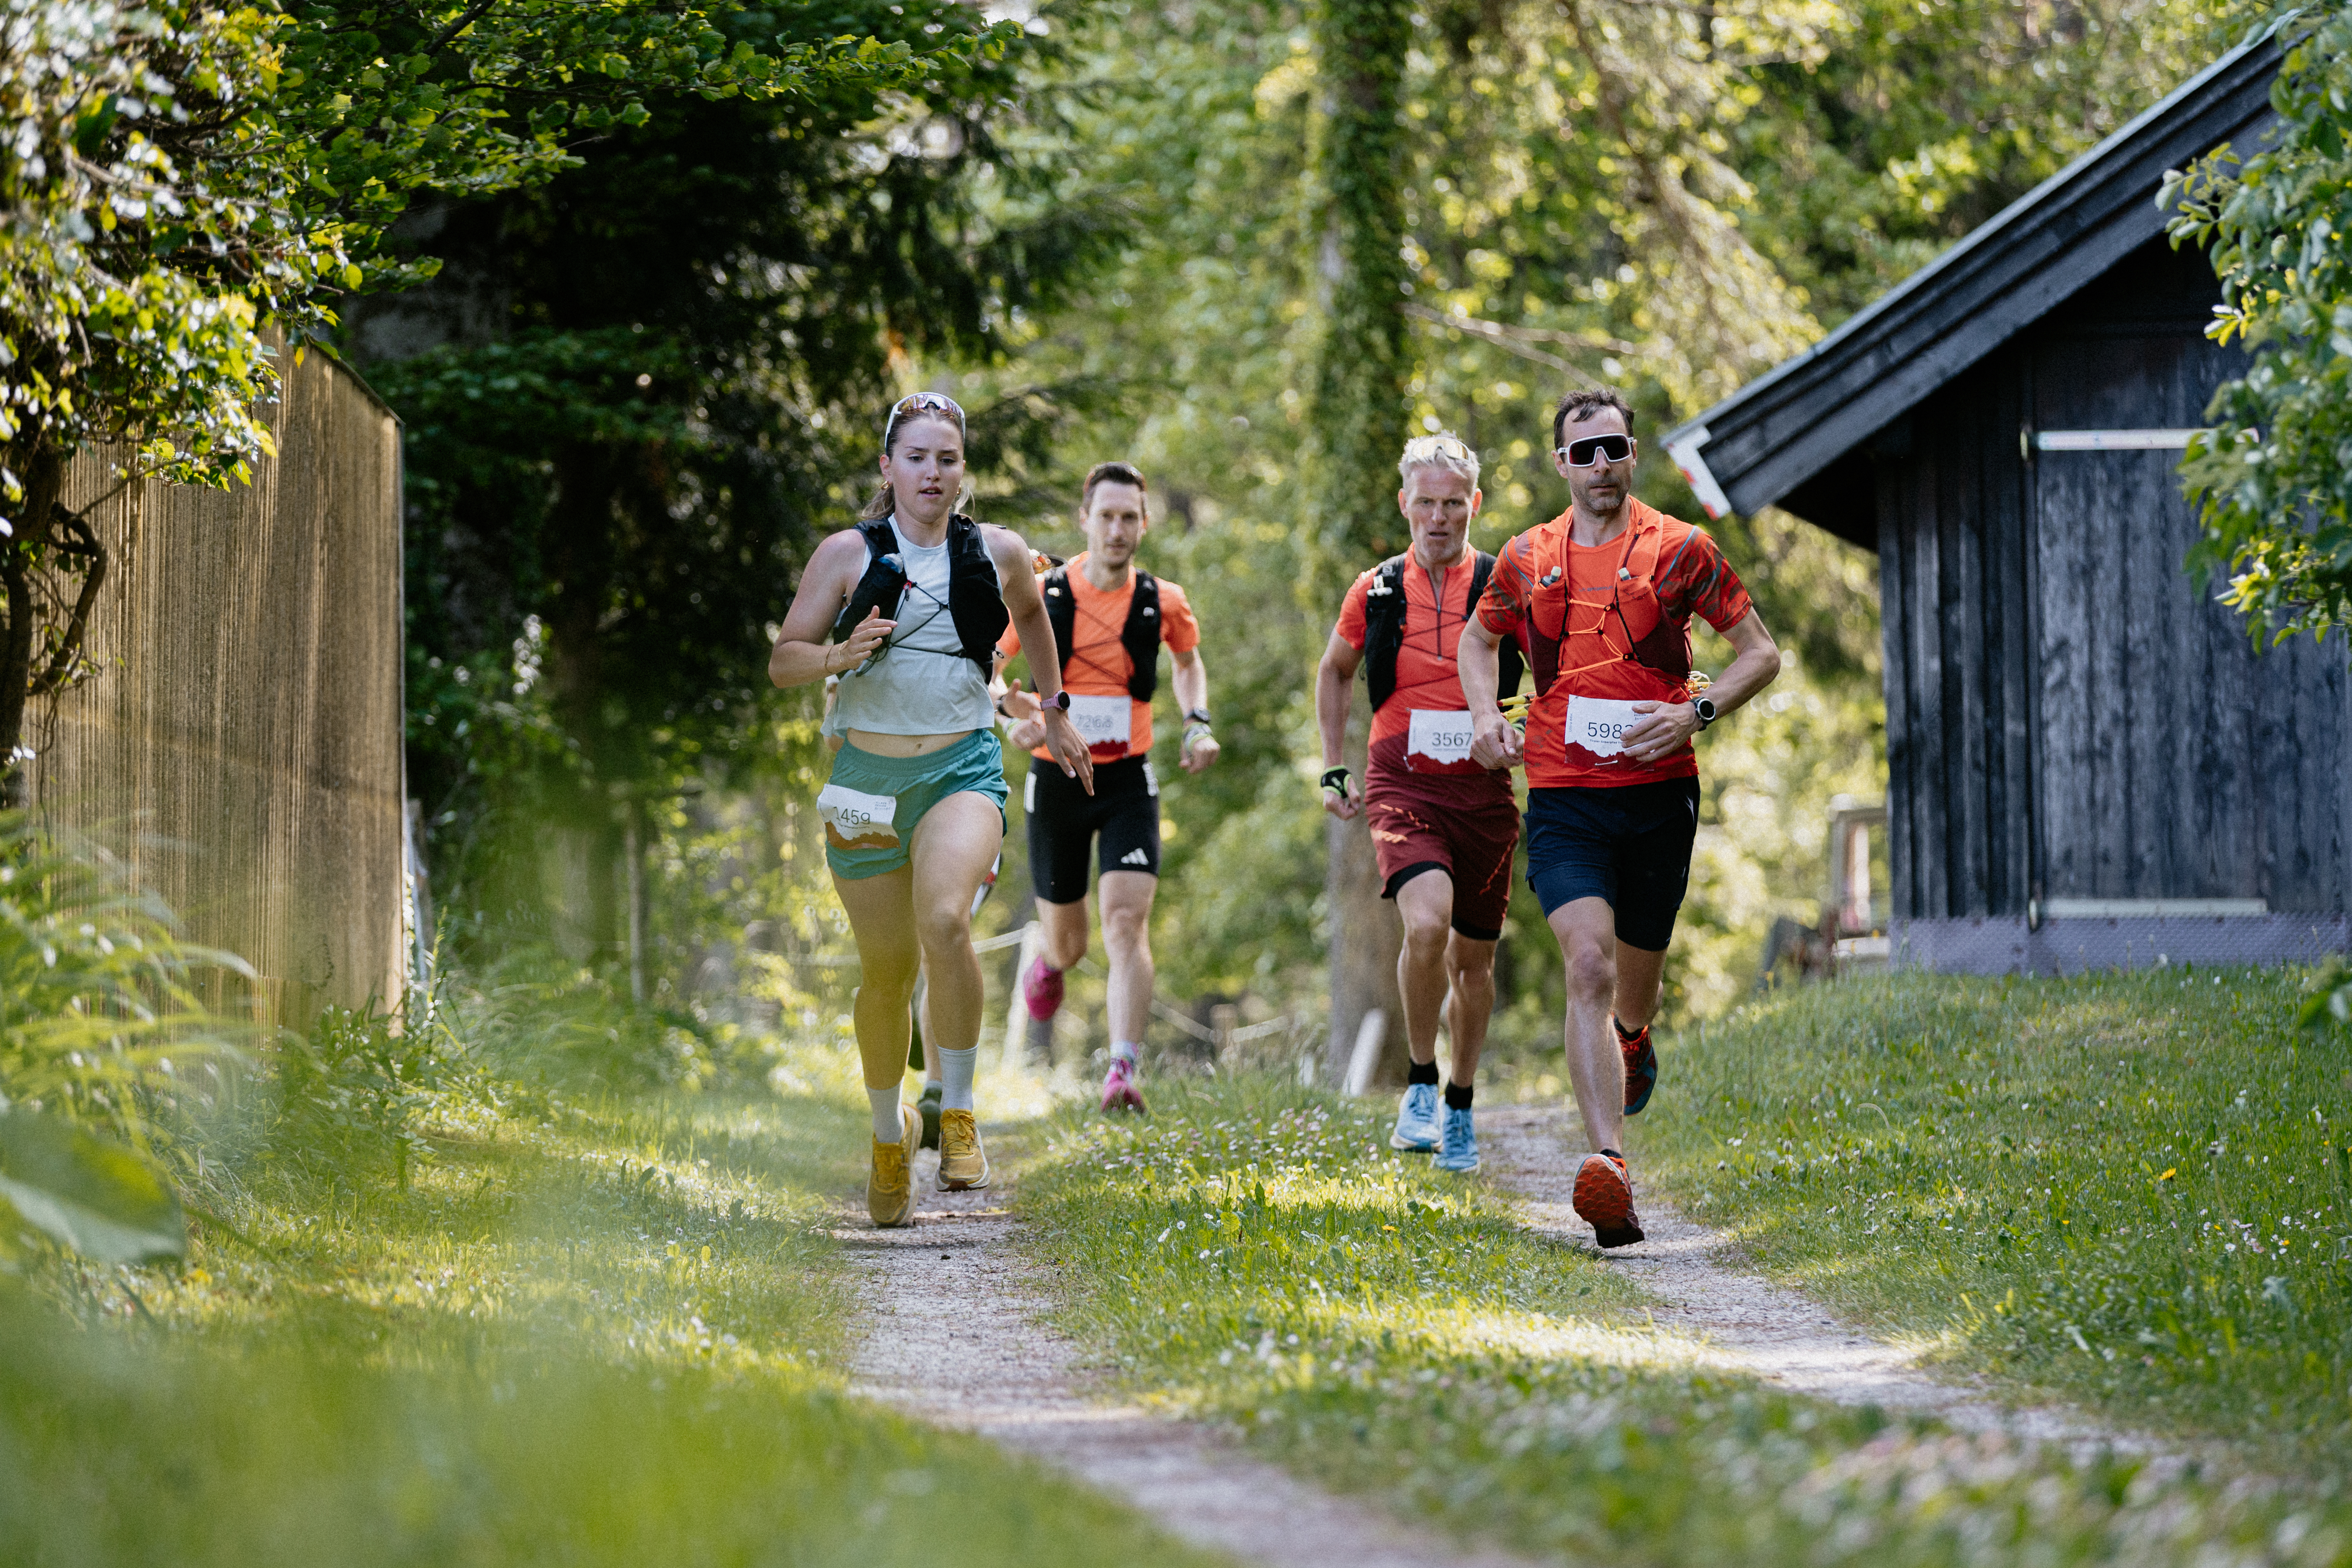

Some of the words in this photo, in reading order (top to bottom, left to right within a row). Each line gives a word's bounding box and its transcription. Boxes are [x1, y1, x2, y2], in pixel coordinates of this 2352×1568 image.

[1432, 732, 1472, 746] 3567
[1588, 722, 1633, 739] 598
[833, 806, 870, 824] 1459
